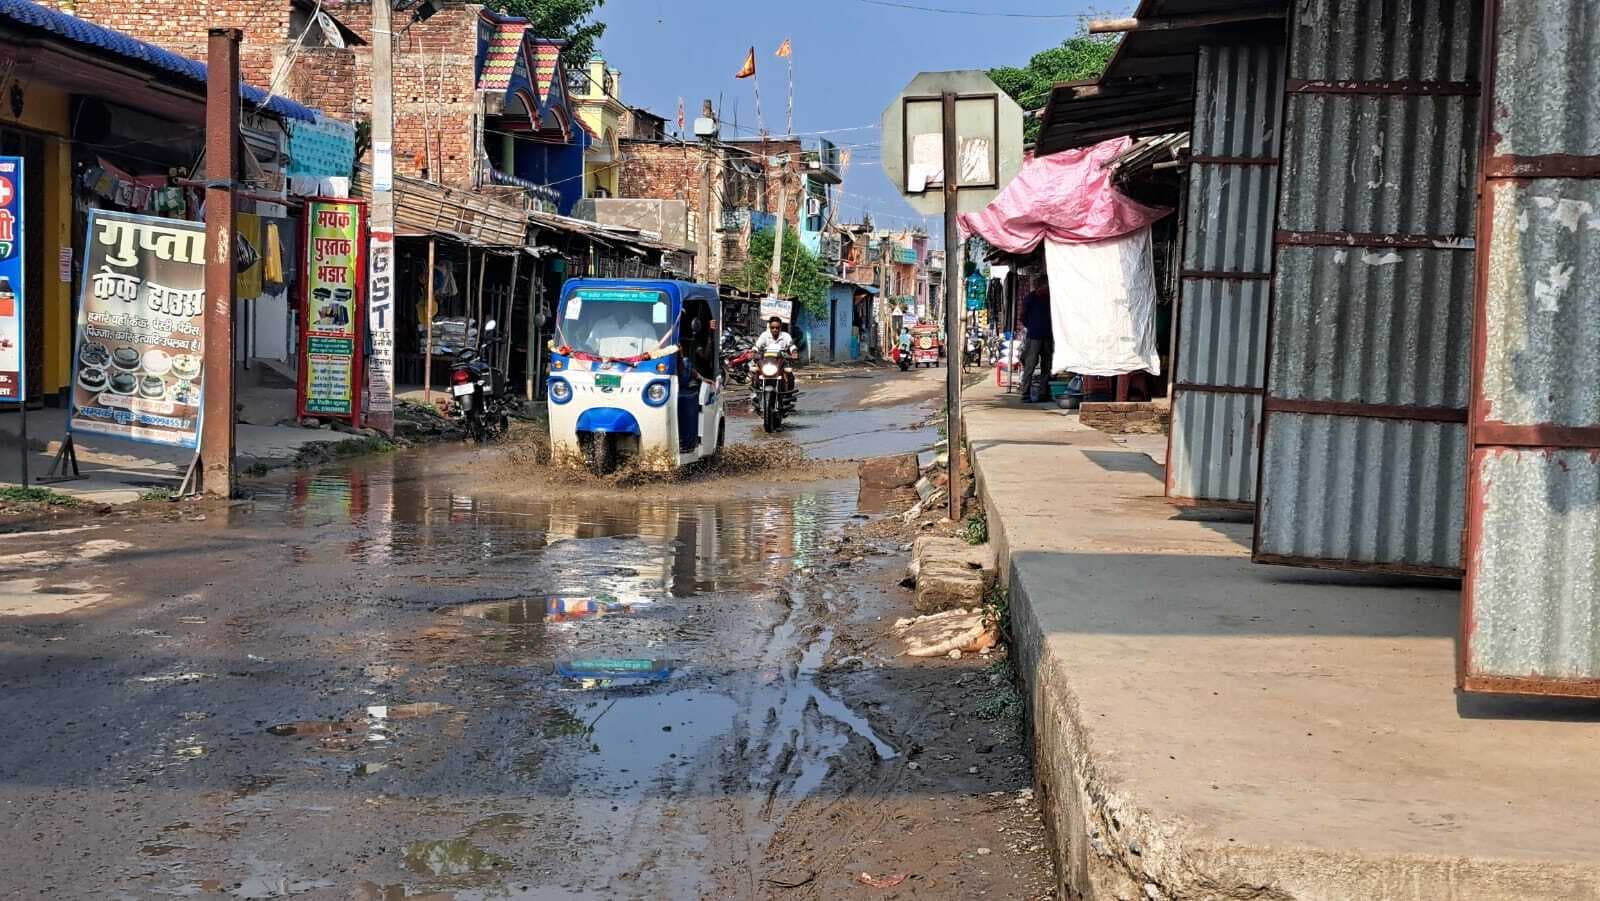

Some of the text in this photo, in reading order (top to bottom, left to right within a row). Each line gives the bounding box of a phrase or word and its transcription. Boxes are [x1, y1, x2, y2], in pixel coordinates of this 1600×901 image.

[318, 205, 350, 228] मयंक
[95, 218, 206, 267] गुप्ता
[314, 238, 352, 261] पुस्तक
[317, 260, 348, 283] भंडार
[92, 265, 205, 317] केक हाउस
